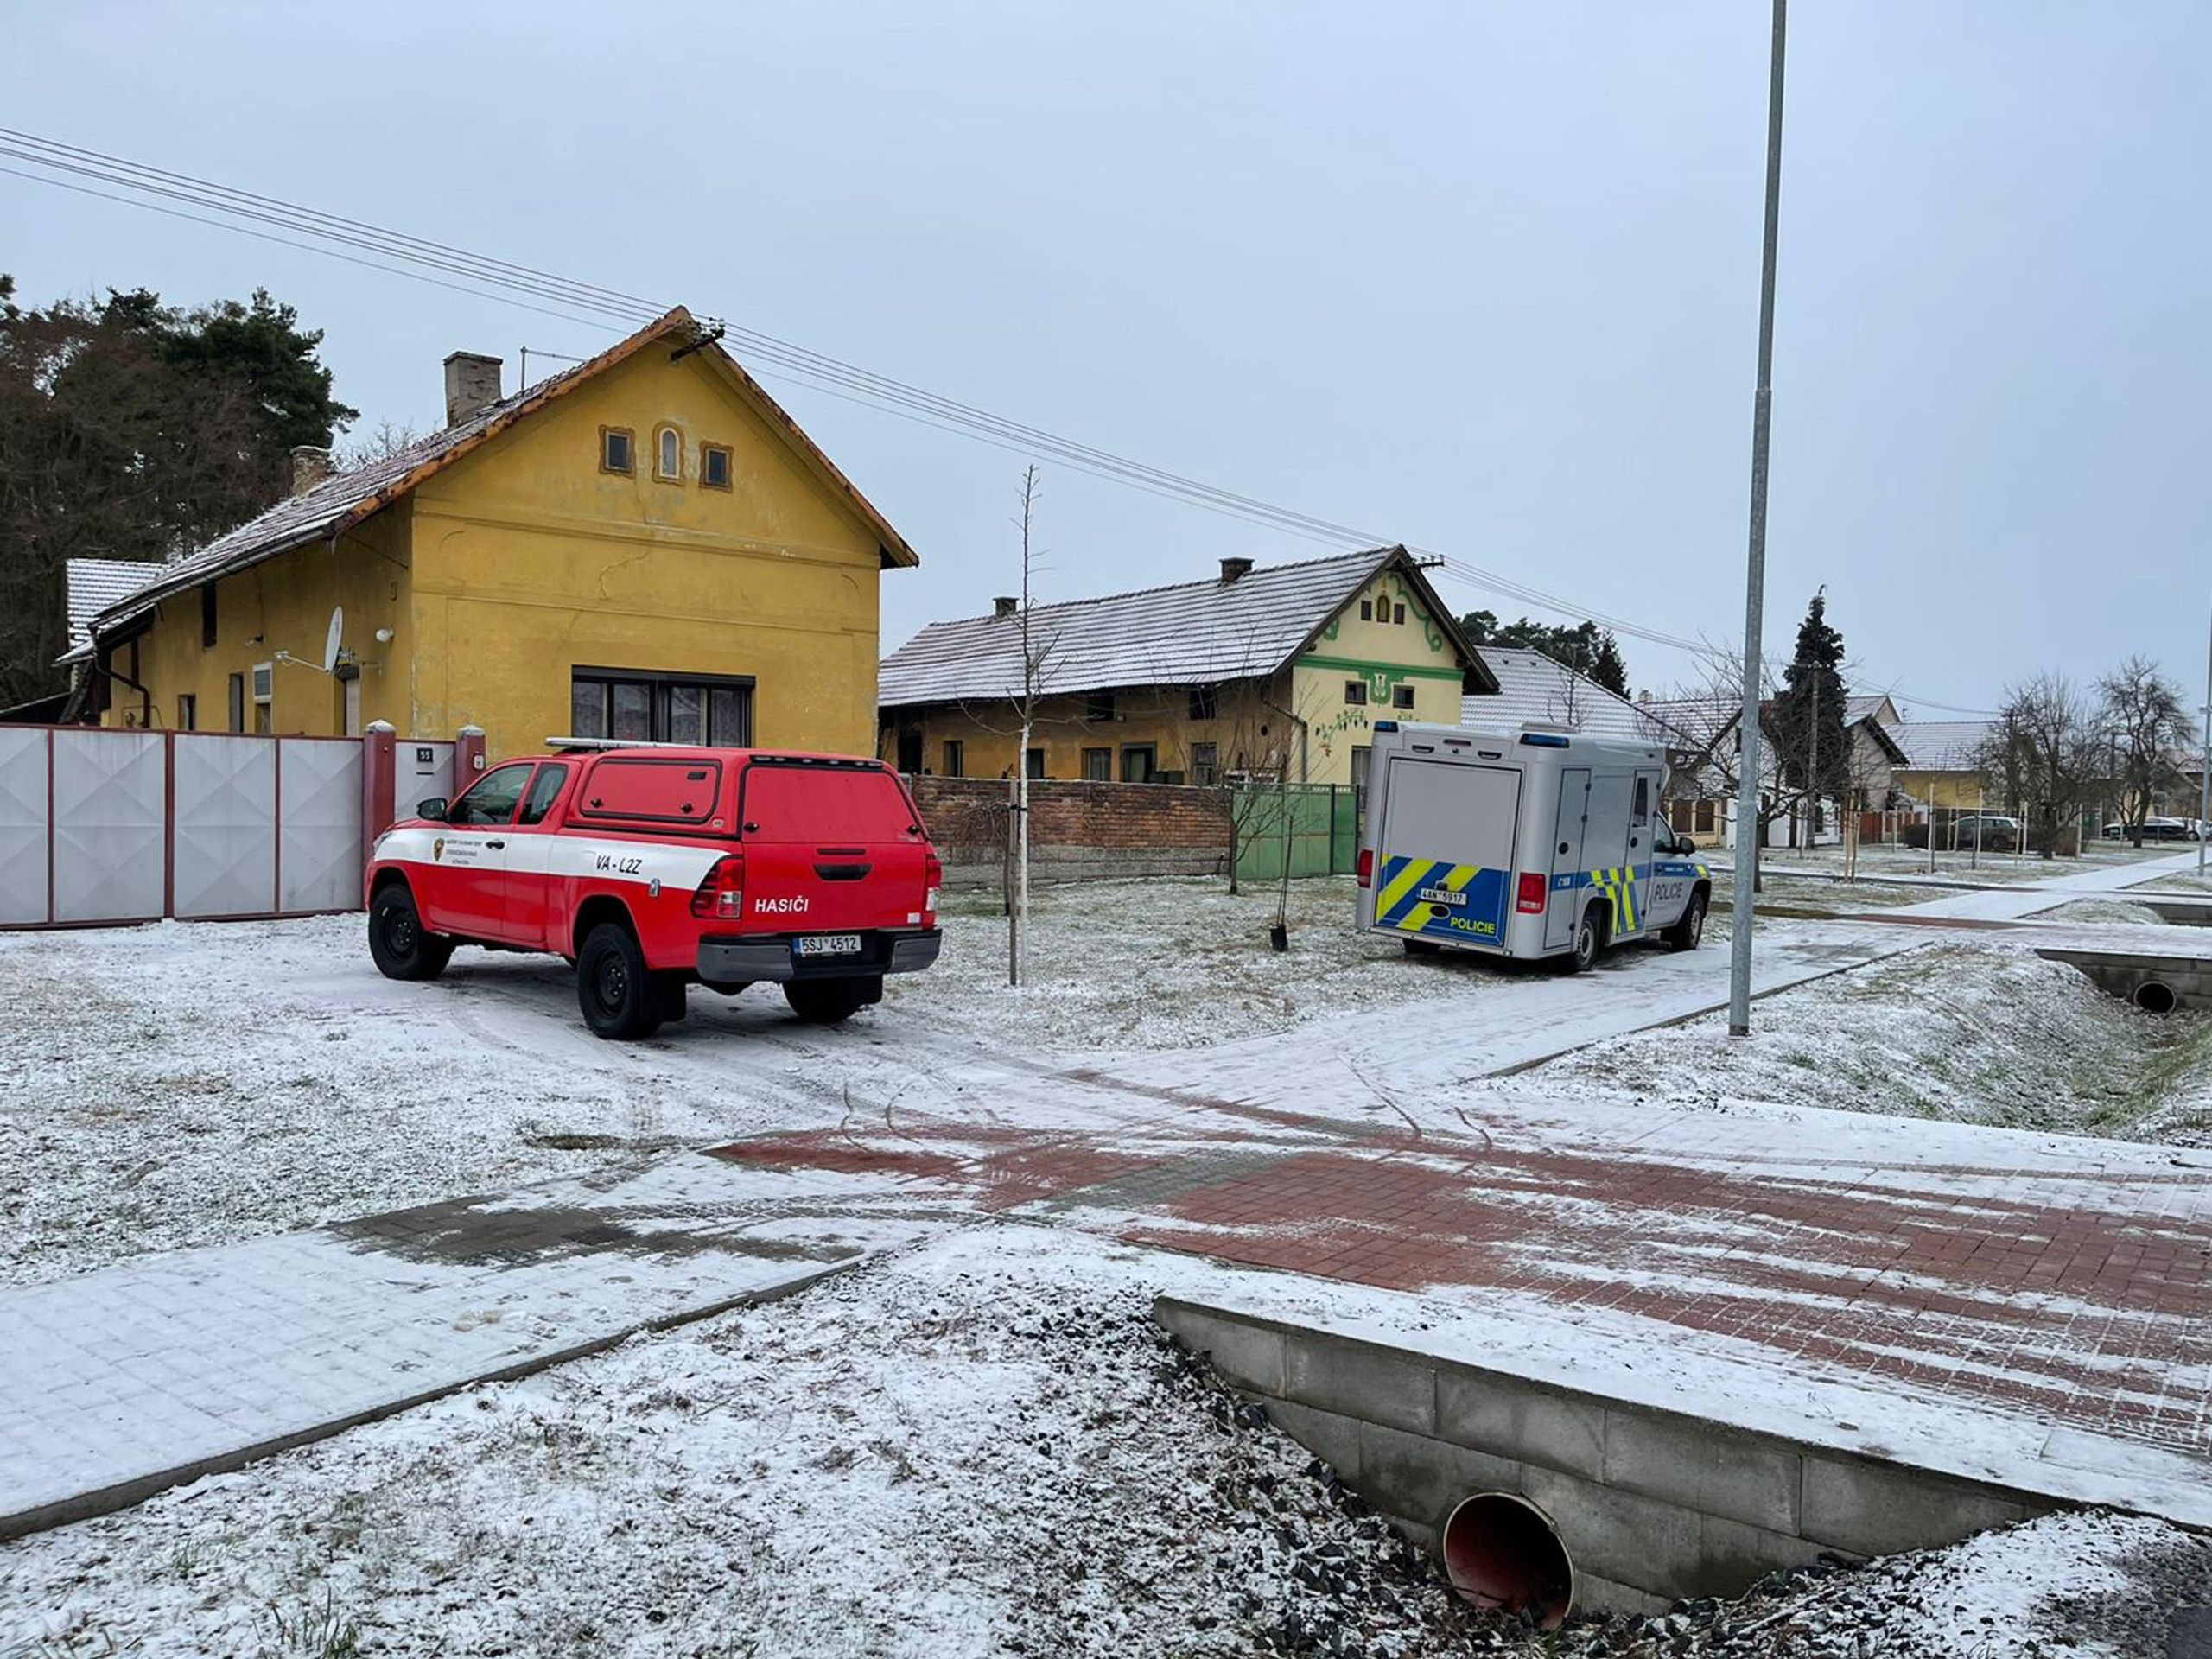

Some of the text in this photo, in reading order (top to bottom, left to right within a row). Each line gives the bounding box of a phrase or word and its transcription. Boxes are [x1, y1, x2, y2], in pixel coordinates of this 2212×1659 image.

[596, 854, 611, 870] VA
[618, 857, 643, 874] L2Z
[1654, 882, 1683, 900] POLICIE
[754, 894, 809, 913] HASIČI
[1450, 916, 1496, 934] POLICIE
[802, 937, 856, 952] 5SJ 4512
